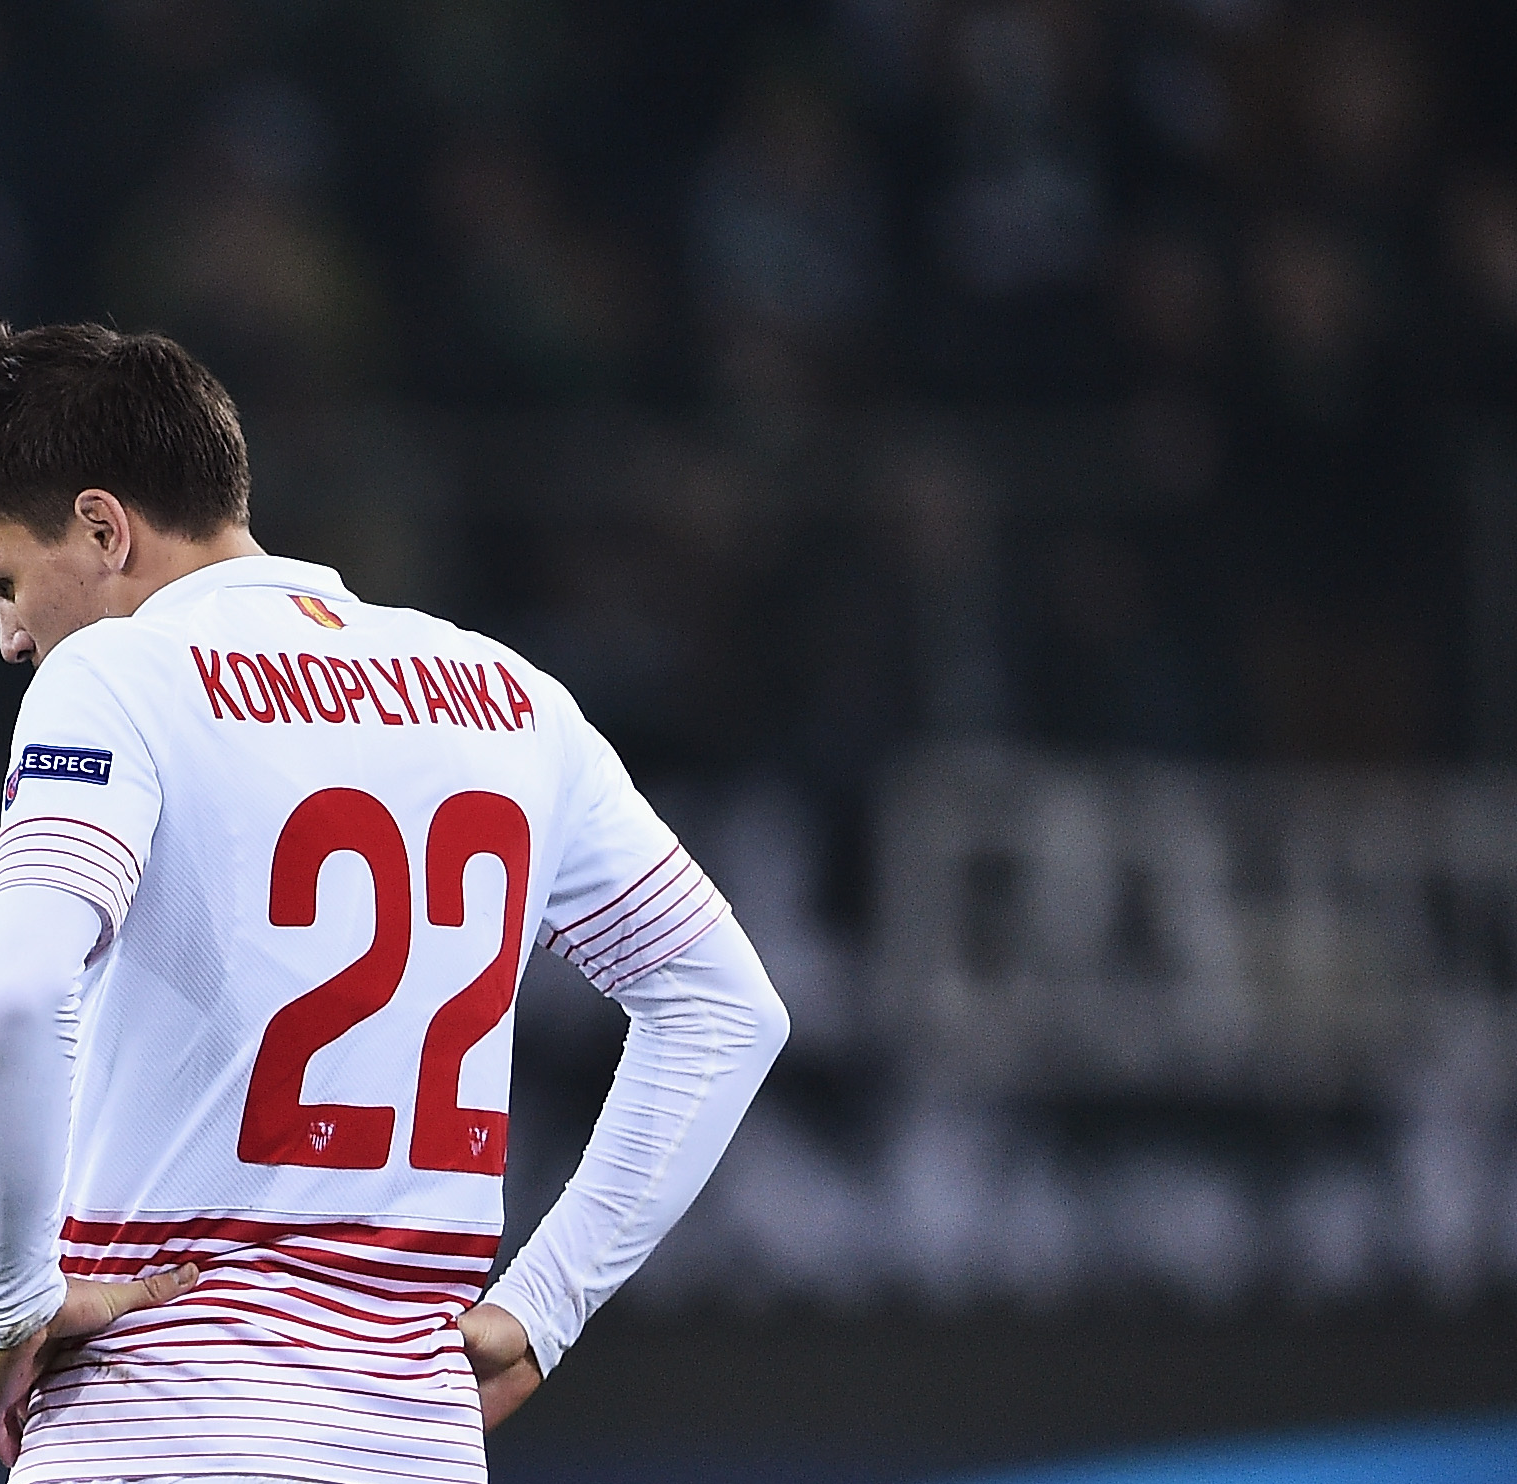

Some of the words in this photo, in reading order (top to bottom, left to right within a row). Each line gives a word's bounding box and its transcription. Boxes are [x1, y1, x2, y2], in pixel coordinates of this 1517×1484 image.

[190, 646, 536, 732] KONOPLYANKA
[20, 753, 111, 776] ESPECT
[237, 787, 531, 1177] 22
